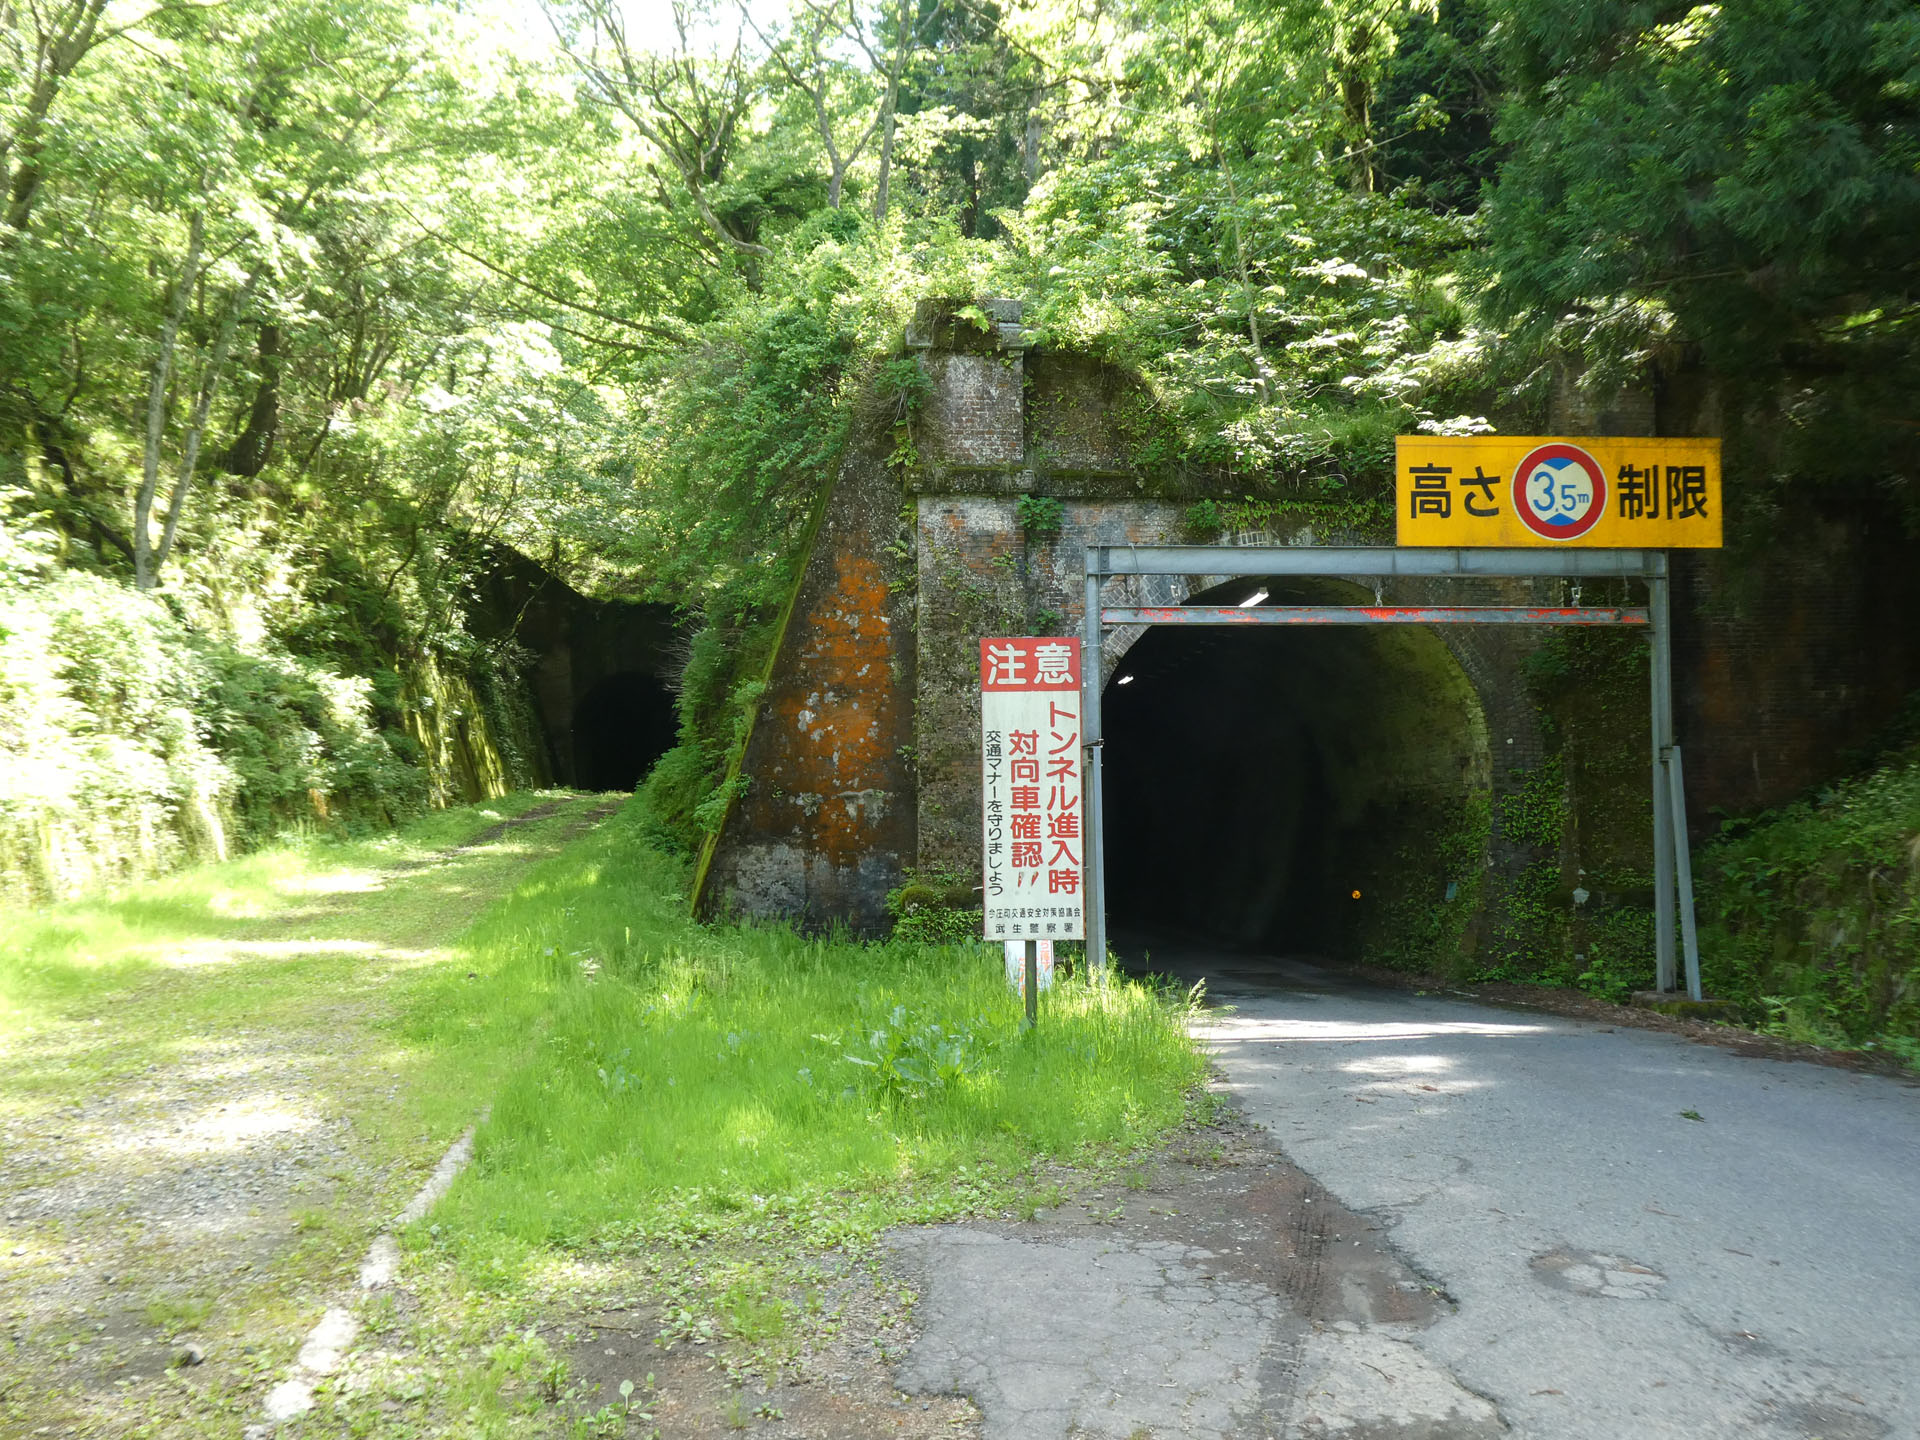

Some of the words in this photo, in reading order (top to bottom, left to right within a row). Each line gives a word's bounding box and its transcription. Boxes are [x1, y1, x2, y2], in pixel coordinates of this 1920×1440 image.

[1408, 463, 1501, 519] 高さ
[1533, 471, 1590, 512] 3.5m
[1616, 463, 1709, 520] 制限
[987, 642, 1074, 686] 注意
[985, 730, 1004, 896] 交通マナーを守りましょう
[1046, 700, 1080, 895] トンネル進入時
[995, 922, 1074, 934] 武生警察署
